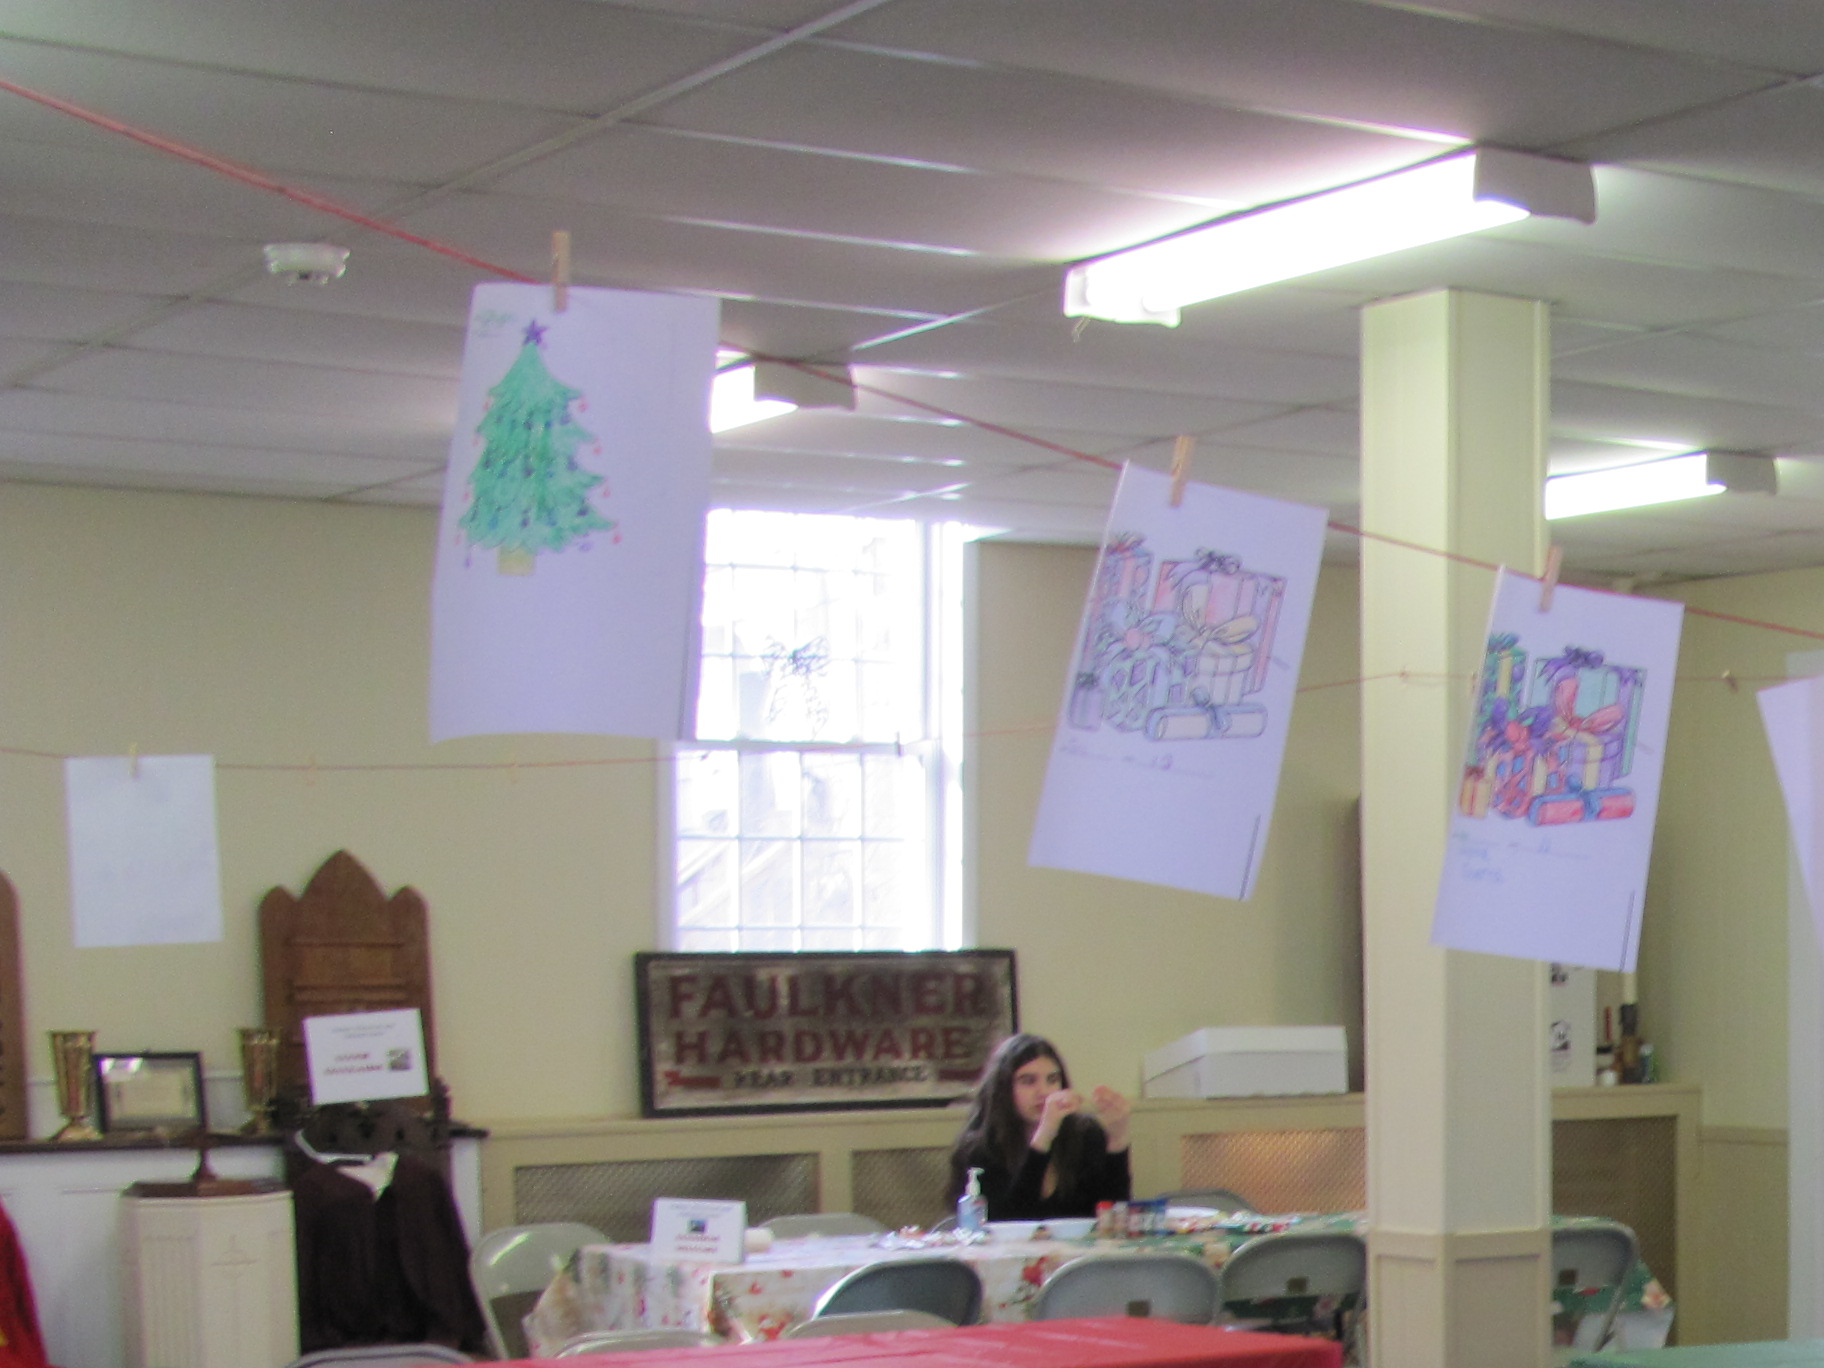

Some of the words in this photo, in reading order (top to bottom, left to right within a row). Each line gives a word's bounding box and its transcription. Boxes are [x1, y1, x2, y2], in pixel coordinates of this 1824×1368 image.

[668, 972, 991, 1020] FAULKNER
[673, 1025, 972, 1065] HARDWARE
[812, 1064, 930, 1088] ENTRANCE
